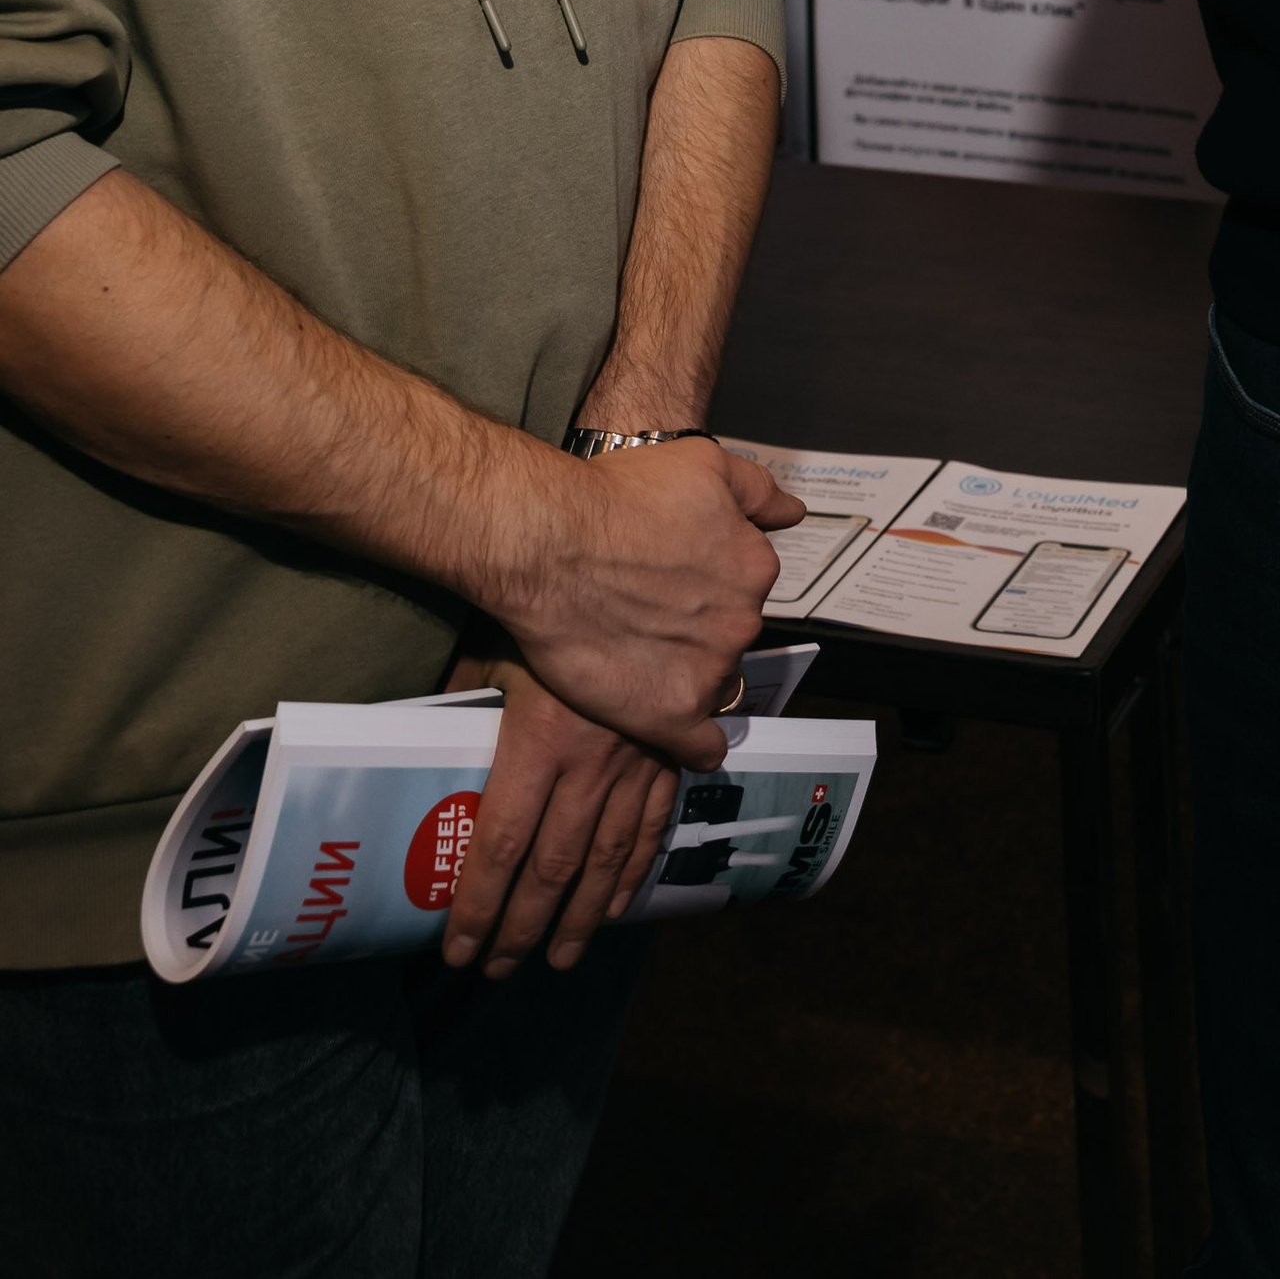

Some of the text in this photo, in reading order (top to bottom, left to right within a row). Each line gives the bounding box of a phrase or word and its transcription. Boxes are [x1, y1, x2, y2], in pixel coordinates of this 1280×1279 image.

[434, 803, 456, 872] FEEL
[764, 802, 832, 897] MS
[807, 809, 843, 878] ME SMILE.
